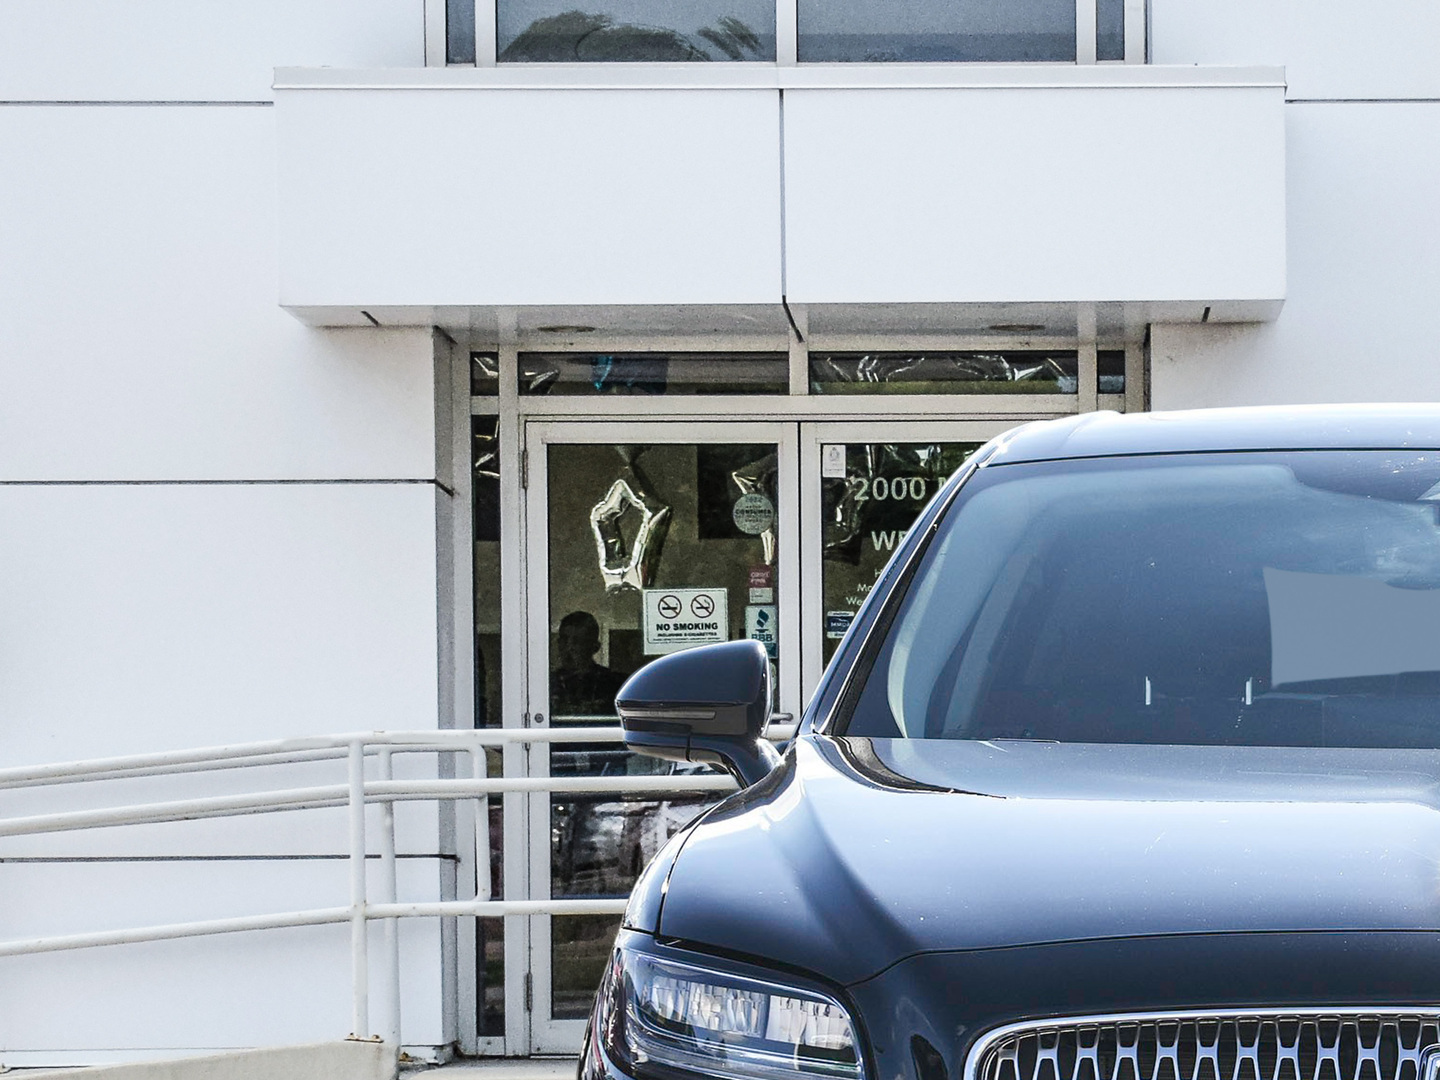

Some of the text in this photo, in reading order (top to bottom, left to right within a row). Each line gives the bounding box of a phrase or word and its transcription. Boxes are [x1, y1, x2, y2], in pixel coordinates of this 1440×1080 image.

[854, 476, 926, 501] 2000
[656, 622, 718, 631] NO SMOKING
